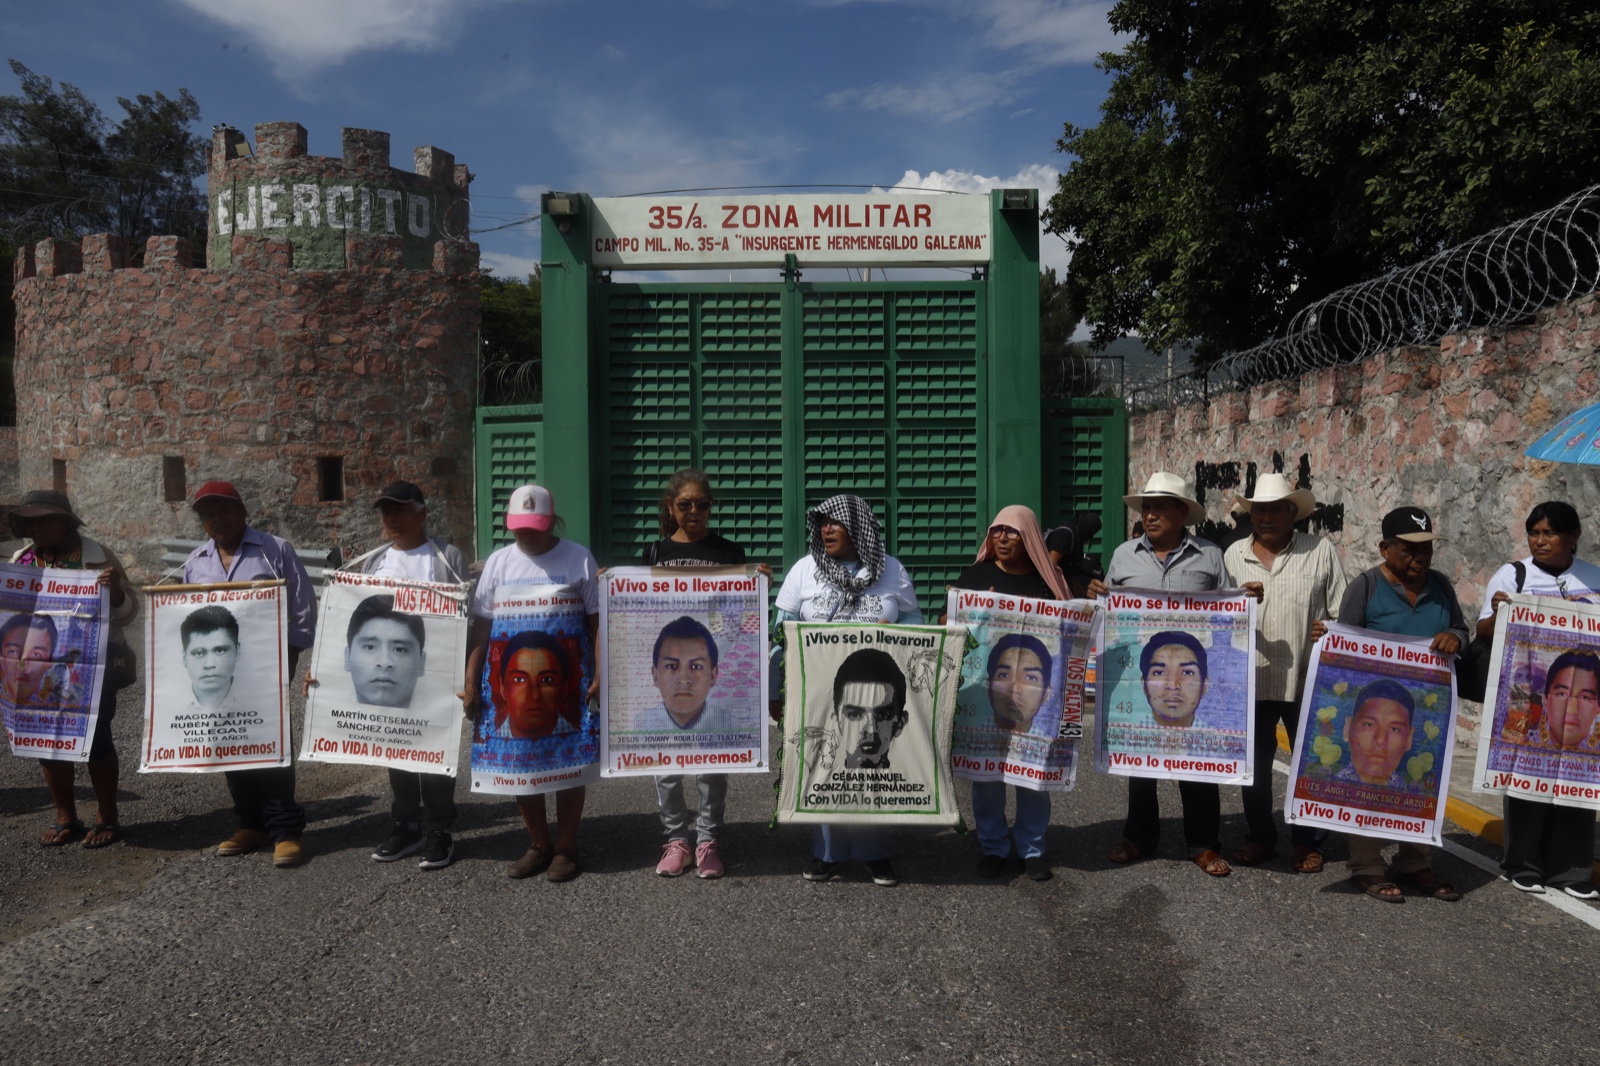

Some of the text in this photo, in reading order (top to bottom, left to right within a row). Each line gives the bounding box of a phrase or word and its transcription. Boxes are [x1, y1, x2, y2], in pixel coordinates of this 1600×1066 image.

[722, 205, 799, 229] ZONA
[813, 204, 932, 228] MILITAR
[595, 237, 639, 253] CAMPO
[645, 237, 671, 252] MIL.
[674, 237, 694, 251] No.
[698, 237, 729, 251] 35-A
[827, 235, 918, 251] HERMENEGILDO
[6, 578, 99, 595] se lo llevaron!
[366, 576, 380, 586] se
[610, 577, 757, 596] ¡Vivo se lo llevaron!
[155, 592, 187, 608] ¡Vivo
[190, 593, 204, 604] se
[207, 591, 218, 603] lo
[394, 587, 417, 612] NOS
[419, 589, 457, 614] FALTAN
[502, 598, 522, 609] vivo
[525, 599, 536, 607] se
[538, 598, 548, 606] lo
[959, 593, 994, 609] ¡Vivo
[998, 598, 1015, 610] se
[1019, 599, 1032, 613] lo
[1036, 600, 1094, 623] llevaron!
[1107, 595, 1247, 612] ¡Vivo se lo llevaron!
[1511, 606, 1545, 624] ¡Vivo
[1550, 615, 1567, 627] se
[1572, 615, 1584, 629] lo
[806, 630, 935, 647] ¡Vivo se lo llevaron!
[1324, 634, 1359, 652] ¡Vivo
[1362, 643, 1377, 656] se
[1381, 643, 1393, 658] lo
[1397, 646, 1449, 668] llevaron!
[1067, 656, 1085, 681] NOS
[1063, 682, 1081, 723] FALTAN
[1116, 701, 1133, 714] 43
[38, 715, 77, 726] MAESTRO
[171, 718, 264, 729] RUBÉN LAURO
[175, 711, 258, 721] MAGDALENO
[331, 709, 430, 727] MARTÍN GETSEMANY
[184, 726, 247, 736] VILLEGAS
[337, 720, 422, 737] SÁNCHEZ GARCÍA
[717, 733, 752, 741] TLATEMPA
[221, 733, 249, 742] AÑOS
[387, 737, 412, 745] AÑOS
[1107, 732, 1125, 740] José
[1129, 733, 1162, 743] Eduardo
[1166, 736, 1200, 745] Bartolo
[1204, 738, 1243, 749] Tlatempa
[154, 742, 276, 762] ¡Con VIDA lo queremos!
[313, 738, 445, 765] ¡Con VIDA lo queremos!
[617, 753, 653, 770] ¡Vivo
[658, 752, 671, 766] lo
[676, 750, 752, 767] queremos!
[1502, 753, 1542, 767] ANTONIO
[985, 758, 995, 771] lo
[998, 762, 1063, 781] queremos!
[1109, 752, 1238, 774] ¡Vivo lo queremos!
[493, 769, 582, 786] ¡Vivo lo queremos!
[832, 772, 906, 782] CÉSAR MANUEL
[1493, 773, 1531, 790] ¡Vivo
[1535, 779, 1548, 793] lo
[813, 781, 925, 792] GONZÁLEZ HERNÁNDEZ
[1299, 781, 1320, 791] LUIS
[1356, 790, 1400, 804] FRANCISCO
[1403, 798, 1434, 809] ARZOLA
[804, 794, 931, 808] ¡Con VIDA lo queremos!
[1299, 802, 1426, 833] ¡Vivo lo queremos!
